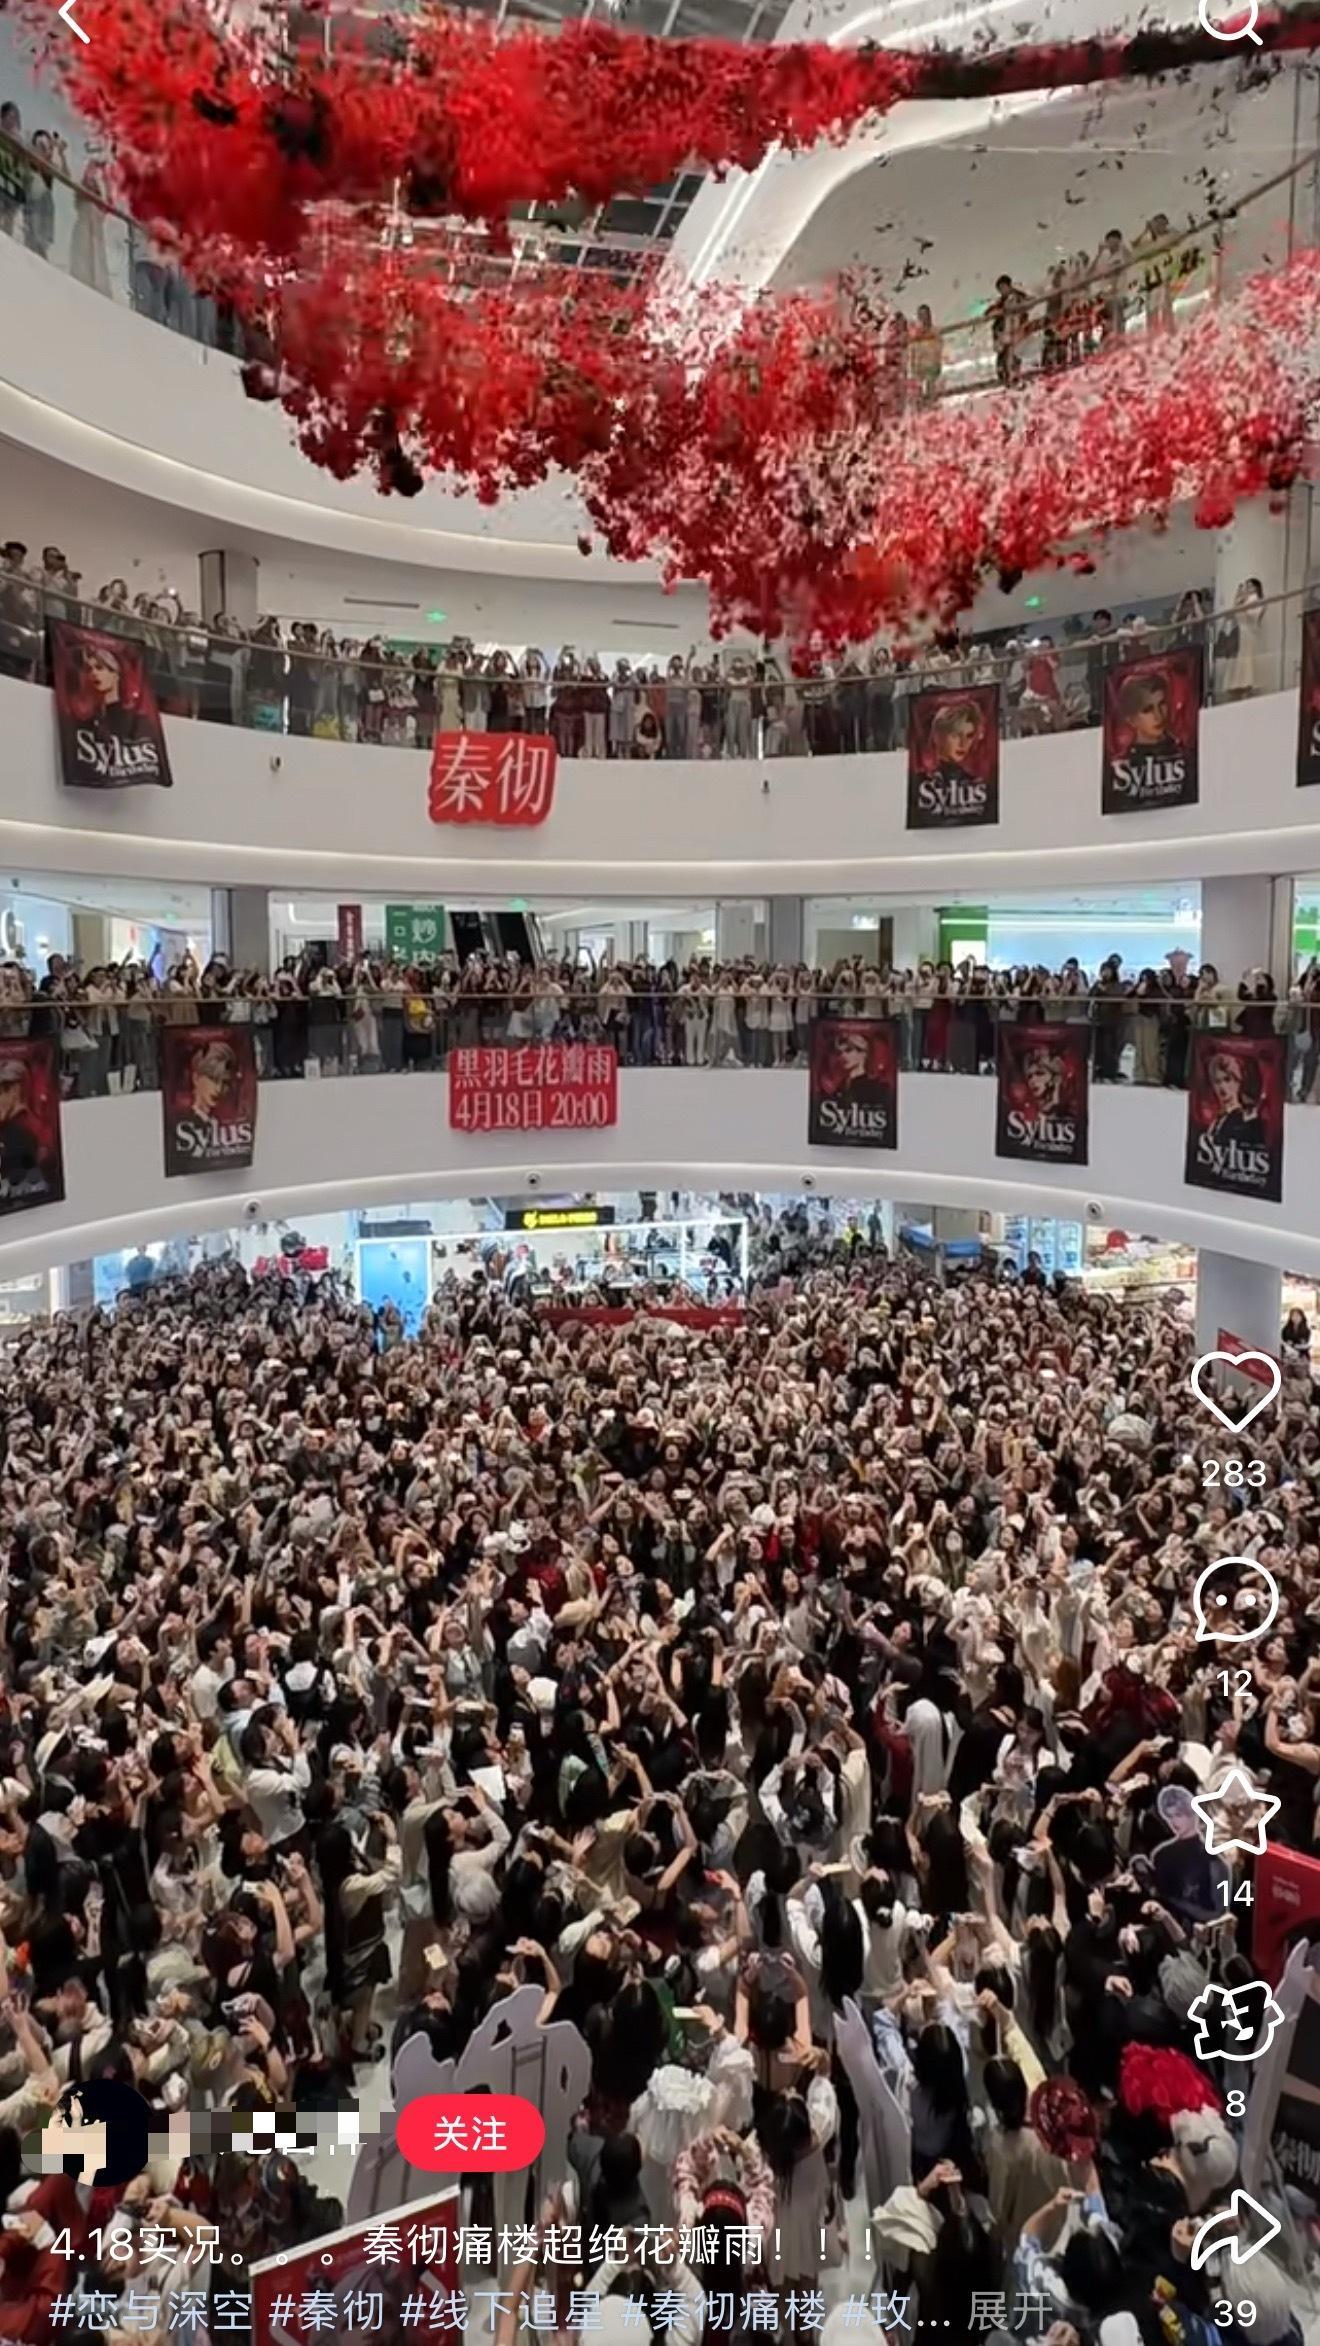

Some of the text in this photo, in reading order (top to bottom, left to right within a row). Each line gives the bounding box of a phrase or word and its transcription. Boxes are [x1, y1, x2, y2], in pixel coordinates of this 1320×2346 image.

[77, 729, 159, 775] Sylus
[434, 734, 550, 815] 秦彻
[1112, 755, 1185, 796] Sylus
[918, 780, 987, 815] Sylus
[455, 1044, 612, 1089] 黑羽毛花瓣雨
[455, 1090, 608, 1129] 4月18日 20:00
[820, 1100, 887, 1135] Sylus
[1007, 1110, 1076, 1146] Sylus
[176, 1116, 252, 1158] Sylus
[1197, 1133, 1270, 1174] Sylus
